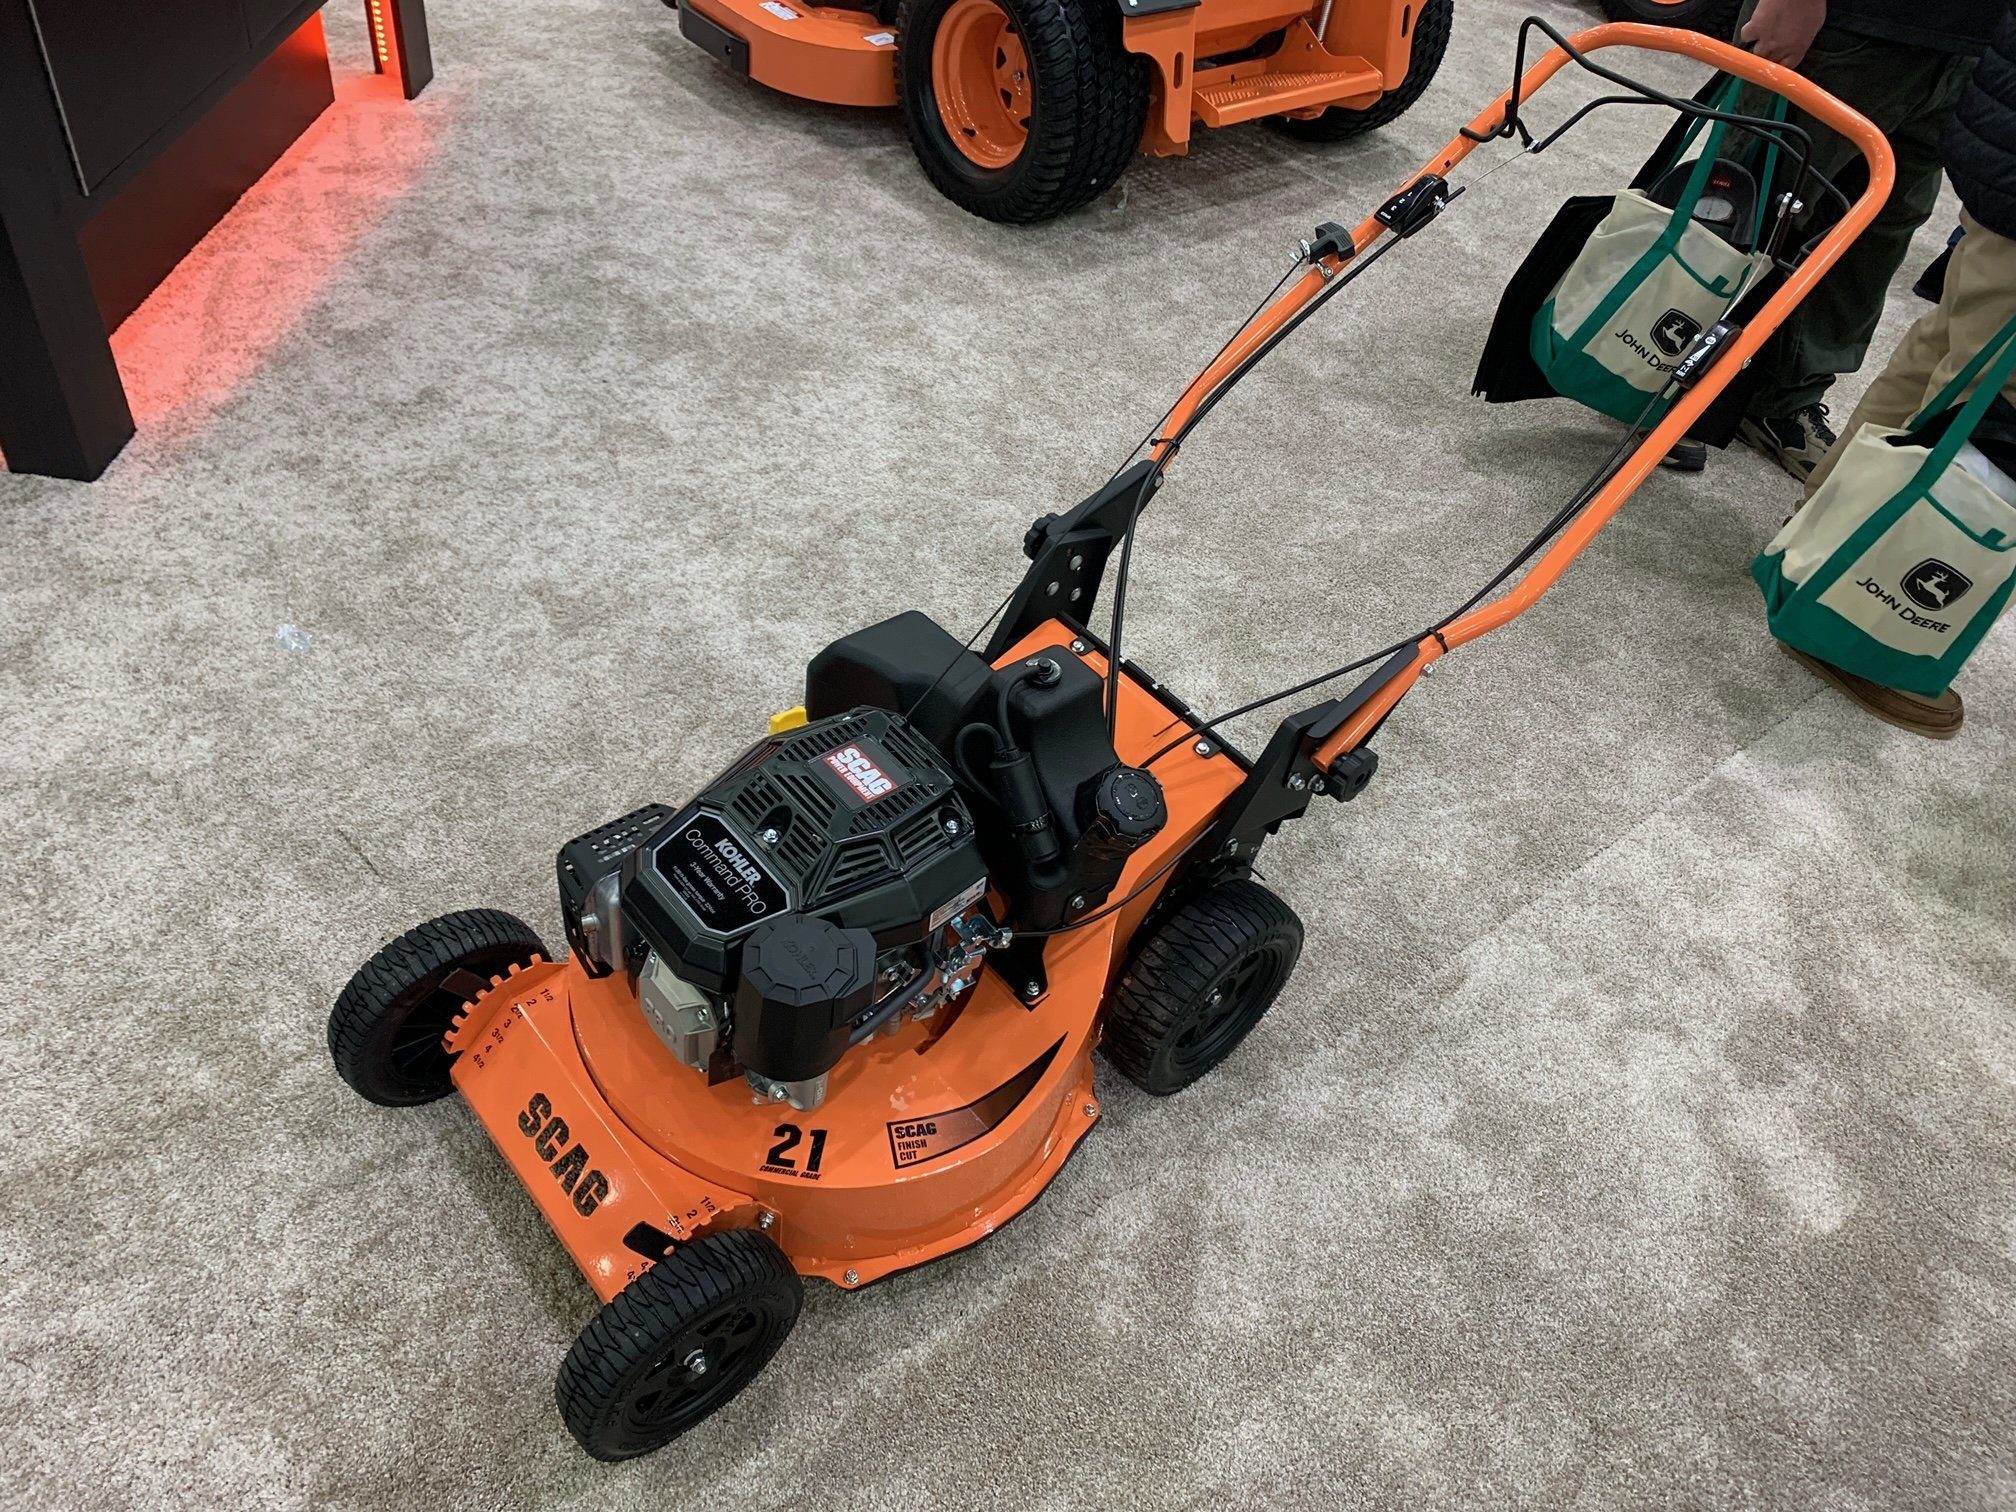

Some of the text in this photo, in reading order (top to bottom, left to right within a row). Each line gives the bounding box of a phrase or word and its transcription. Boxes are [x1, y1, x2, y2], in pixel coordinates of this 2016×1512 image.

[1615, 329, 1678, 373] JOHN DEER
[1856, 577, 1951, 634] JOHN DEERE
[837, 748, 892, 795] SCAG
[685, 829, 743, 888] Command
[735, 884, 766, 914] PRO
[689, 861, 726, 900] 3-Year Warranty
[714, 838, 761, 888] KOHLER
[503, 1018, 512, 1028] 3
[485, 1045, 493, 1053] 4
[766, 1123, 828, 1172] 21
[895, 1122, 937, 1139] SCAG
[897, 1139, 927, 1151] FINISH
[518, 1093, 609, 1217] SCAG
[759, 1165, 821, 1180] COMMERCIAL GRADE
[900, 1150, 917, 1161] CUT
[686, 1209, 698, 1219] 2
